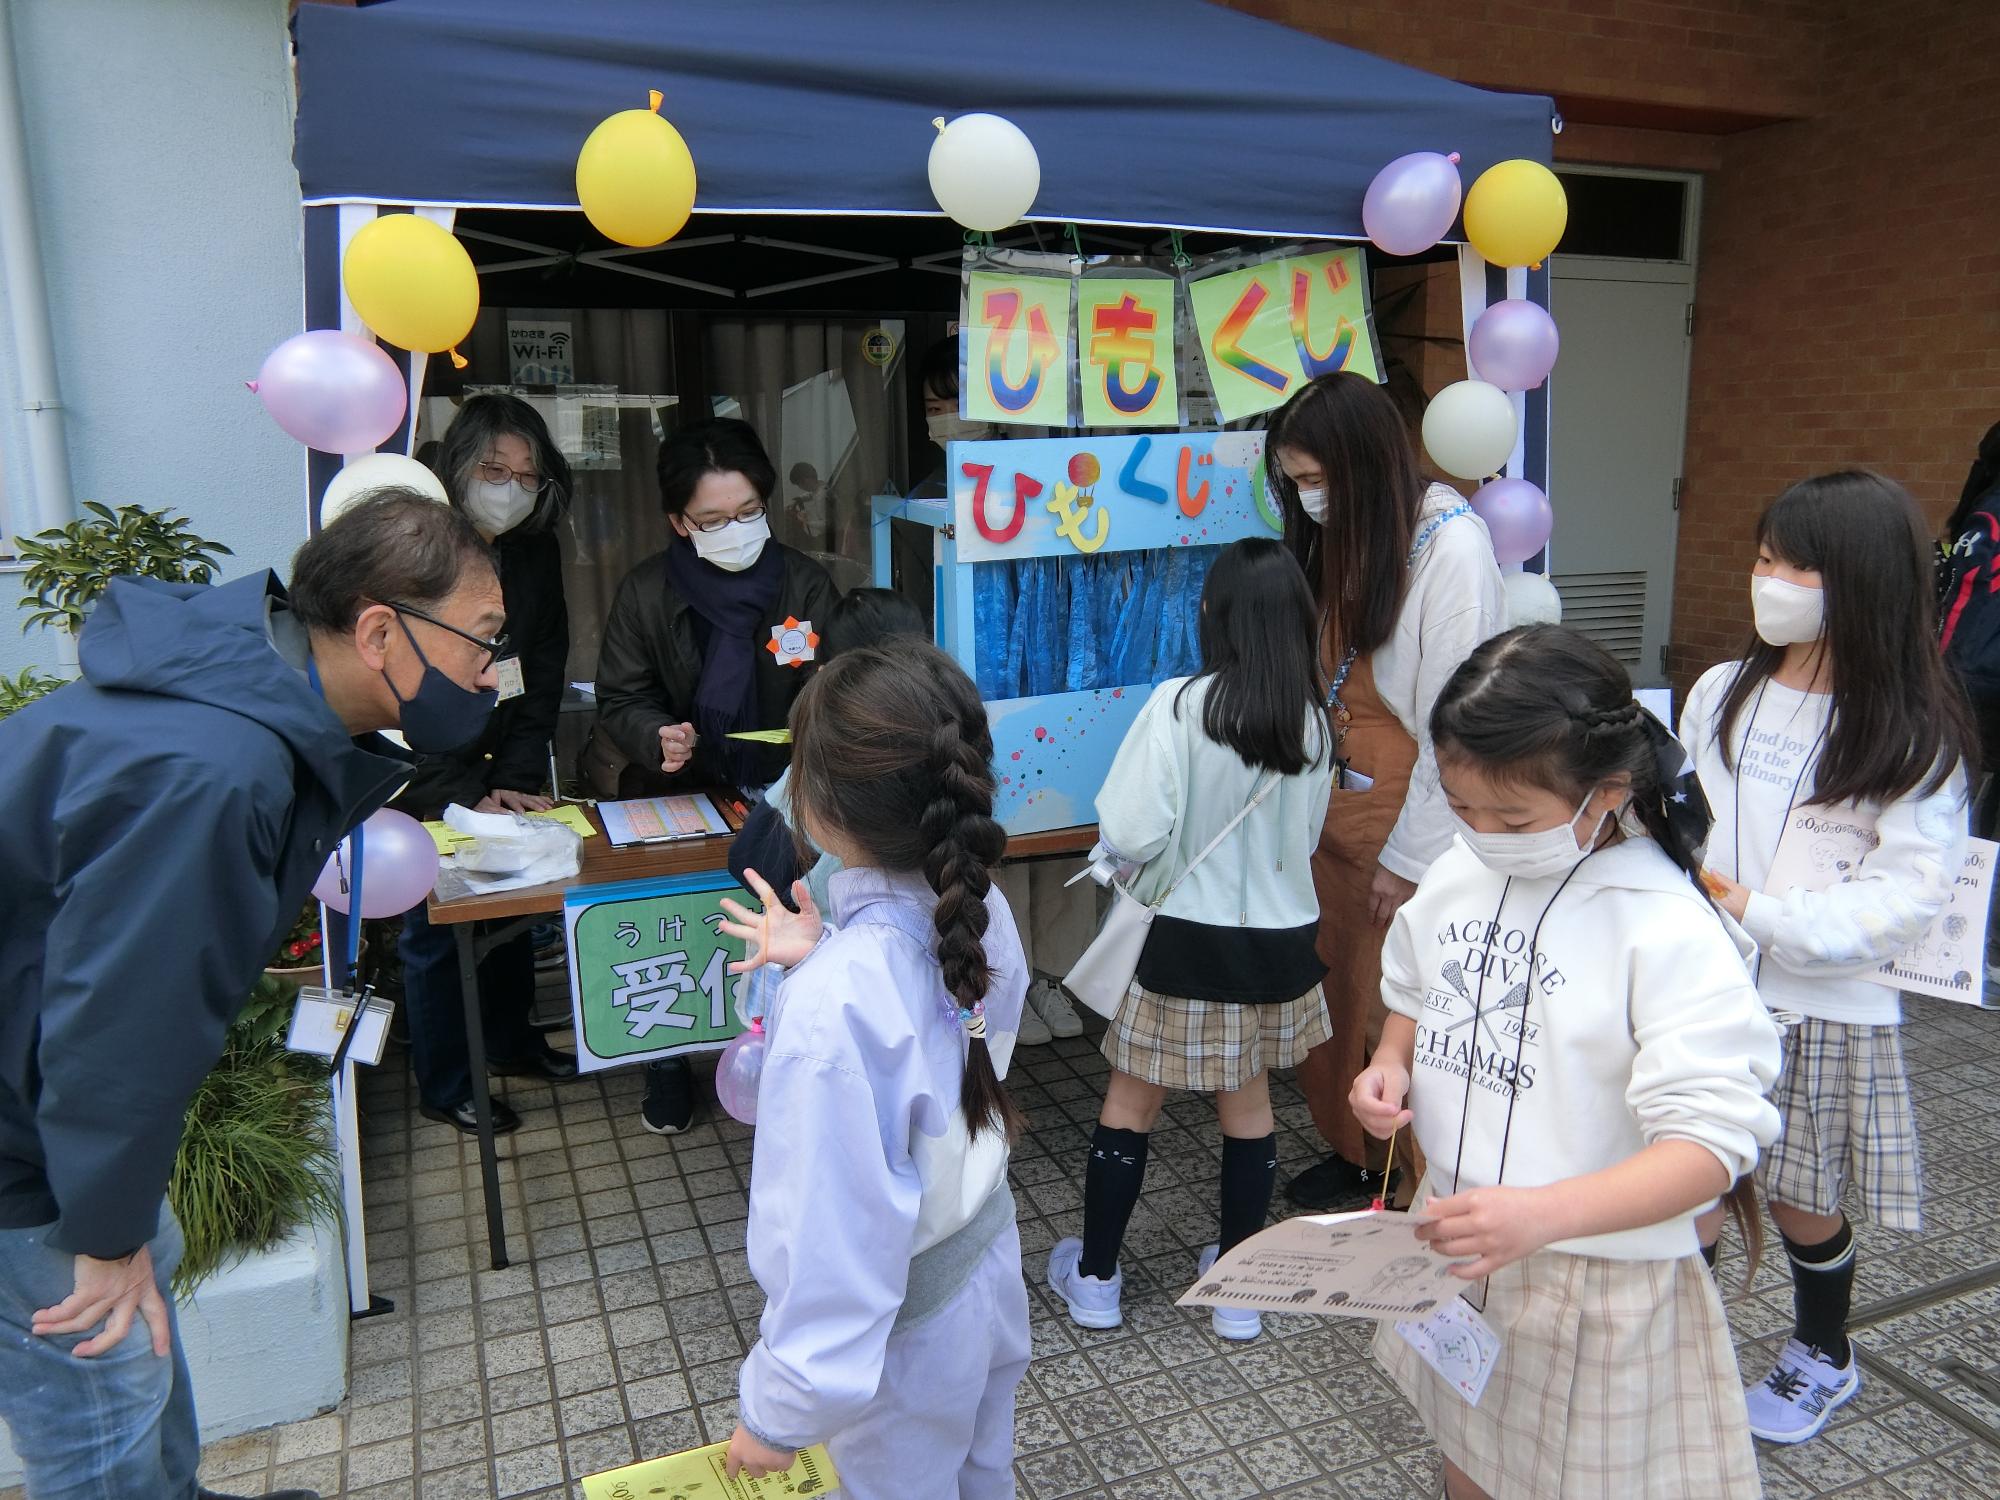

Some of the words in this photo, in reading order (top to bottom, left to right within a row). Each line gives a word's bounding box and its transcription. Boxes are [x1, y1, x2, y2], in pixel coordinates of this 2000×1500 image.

[981, 255, 1358, 416] ひもくじ
[512, 345, 563, 360] Wi-Fi
[961, 436, 1213, 554] ひもくじ
[1764, 750, 1791, 769] the
[1781, 735, 1809, 758] joy
[1437, 919, 1567, 997] LACROSSE
[1462, 947, 1520, 987] DIV.
[1424, 990, 1452, 1012] EST.
[1414, 1024, 1537, 1090] CHAMPS
[1414, 1053, 1469, 1080] LEISURE
